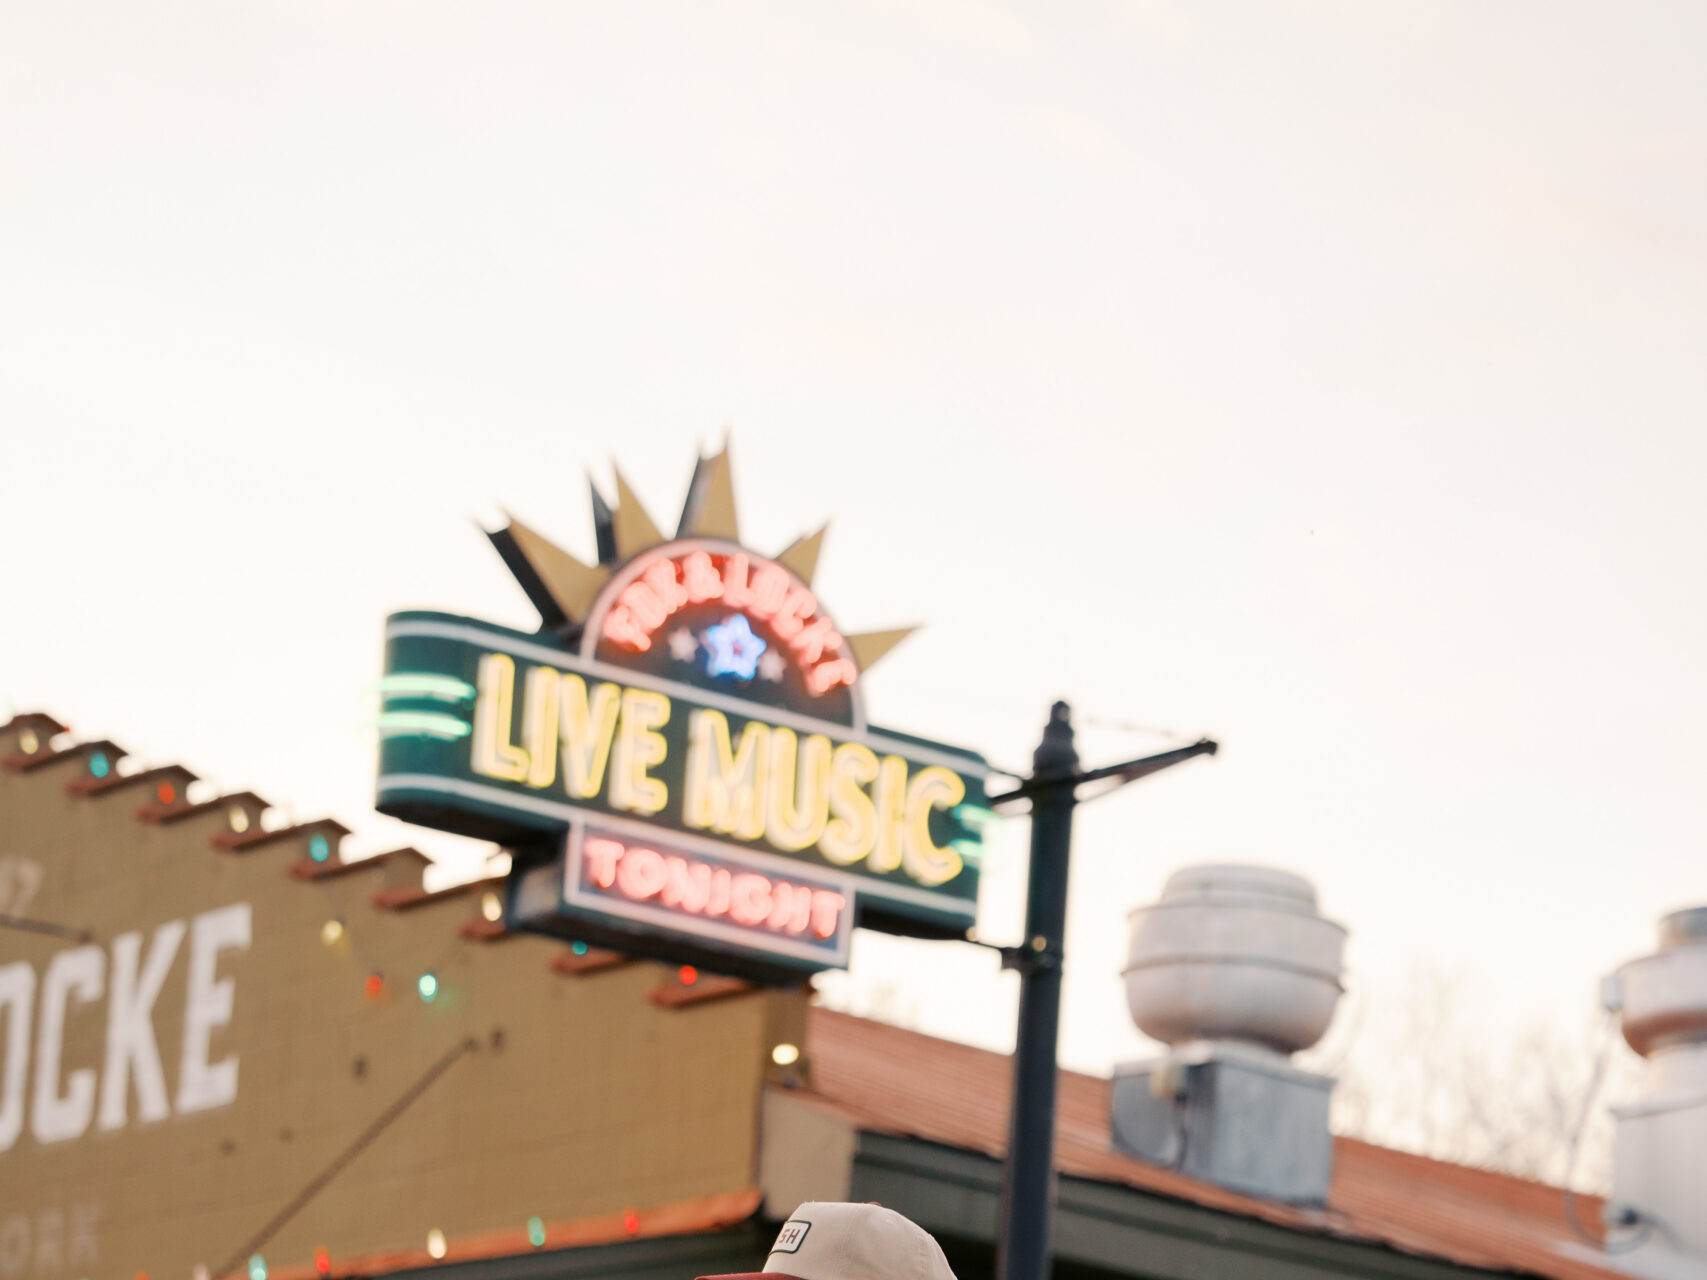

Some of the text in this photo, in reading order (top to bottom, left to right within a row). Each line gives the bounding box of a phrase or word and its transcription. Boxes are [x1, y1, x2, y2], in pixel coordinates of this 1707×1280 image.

[473, 654, 966, 886] LIVE MUSIC
[584, 838, 846, 939] TONIGHT
